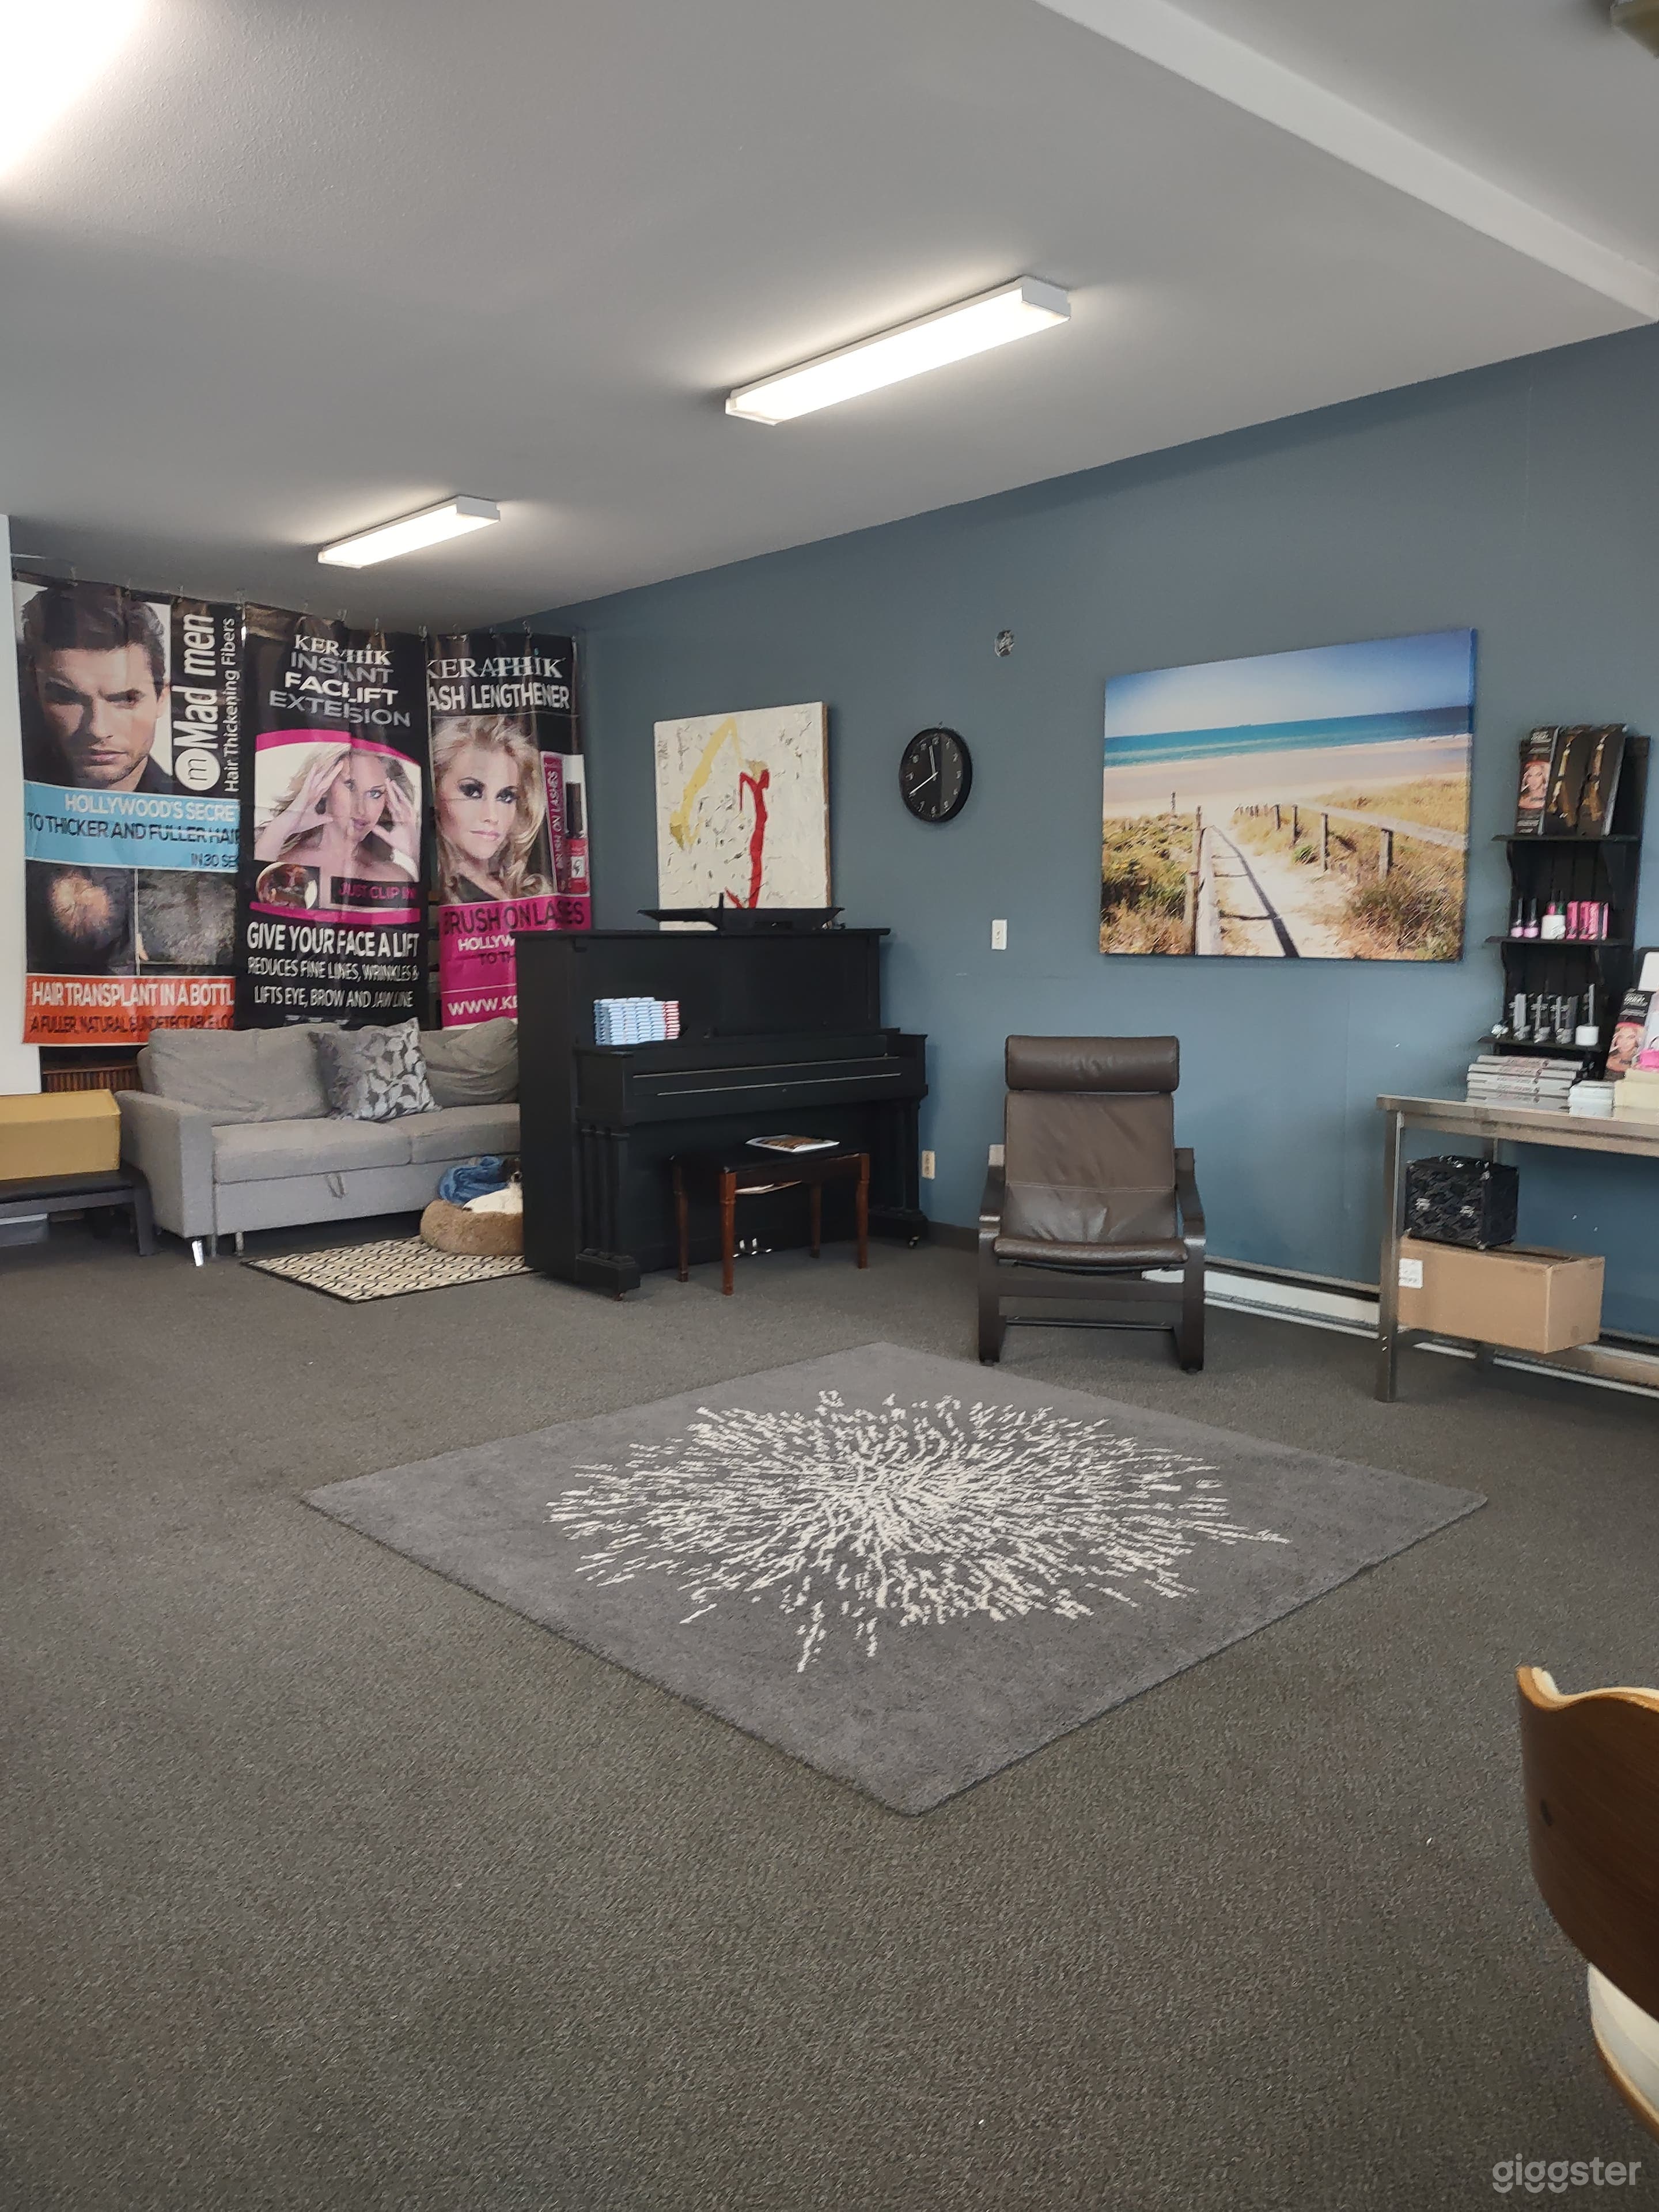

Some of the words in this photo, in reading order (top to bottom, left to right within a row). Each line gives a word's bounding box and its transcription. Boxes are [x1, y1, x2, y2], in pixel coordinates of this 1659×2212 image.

[183, 613, 217, 677] men
[220, 617, 236, 666] Fibers
[470, 681, 570, 710] LENGTHENER
[171, 685, 218, 749] Mad
[222, 669, 241, 757] Thickening
[224, 762, 240, 793] Hair
[65, 793, 183, 820] HOLLYWOOD'S
[27, 812, 44, 831] TO
[46, 815, 109, 838] THICKER
[111, 822, 146, 839] AND
[150, 824, 207, 843] FULLER
[504, 902, 532, 929] ON
[247, 922, 286, 950] GIVE
[288, 925, 335, 955] YOUR
[336, 929, 375, 957] FACE
[377, 932, 391, 958] A
[393, 932, 421, 958] LIFT
[247, 956, 298, 978] REDUCES
[300, 960, 327, 979] FINE
[479, 952, 498, 966] TO
[31, 980, 64, 1006] HAIR
[65, 982, 158, 1007] TRANSPLANT
[160, 983, 175, 1006] IN
[175, 983, 189, 1006] A
[254, 984, 283, 1005] LIFTS
[310, 987, 345, 1007] BROW
[346, 989, 372, 1008] AND
